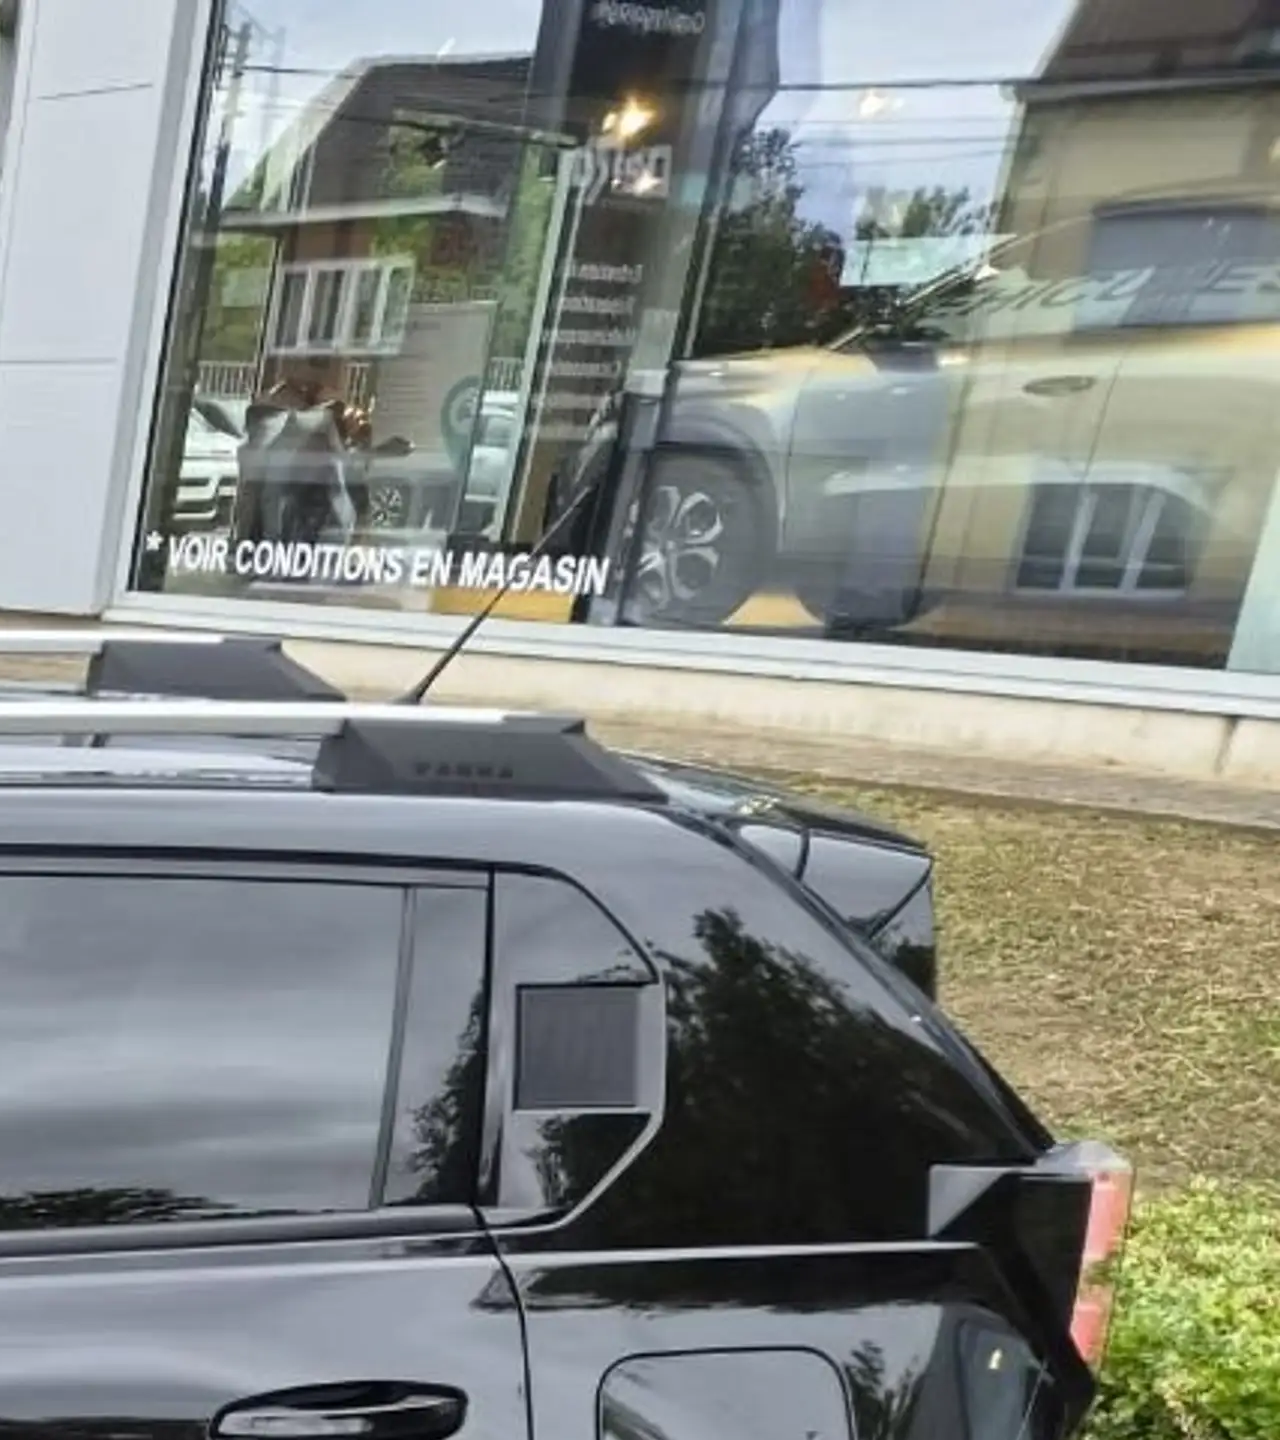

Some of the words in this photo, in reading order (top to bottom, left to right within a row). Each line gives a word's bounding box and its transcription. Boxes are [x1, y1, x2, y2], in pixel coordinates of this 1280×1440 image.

[169, 535, 229, 576] VOIR
[235, 539, 403, 584] CONDITIONS
[409, 549, 454, 587] EN
[458, 551, 610, 595] MAGASIN
